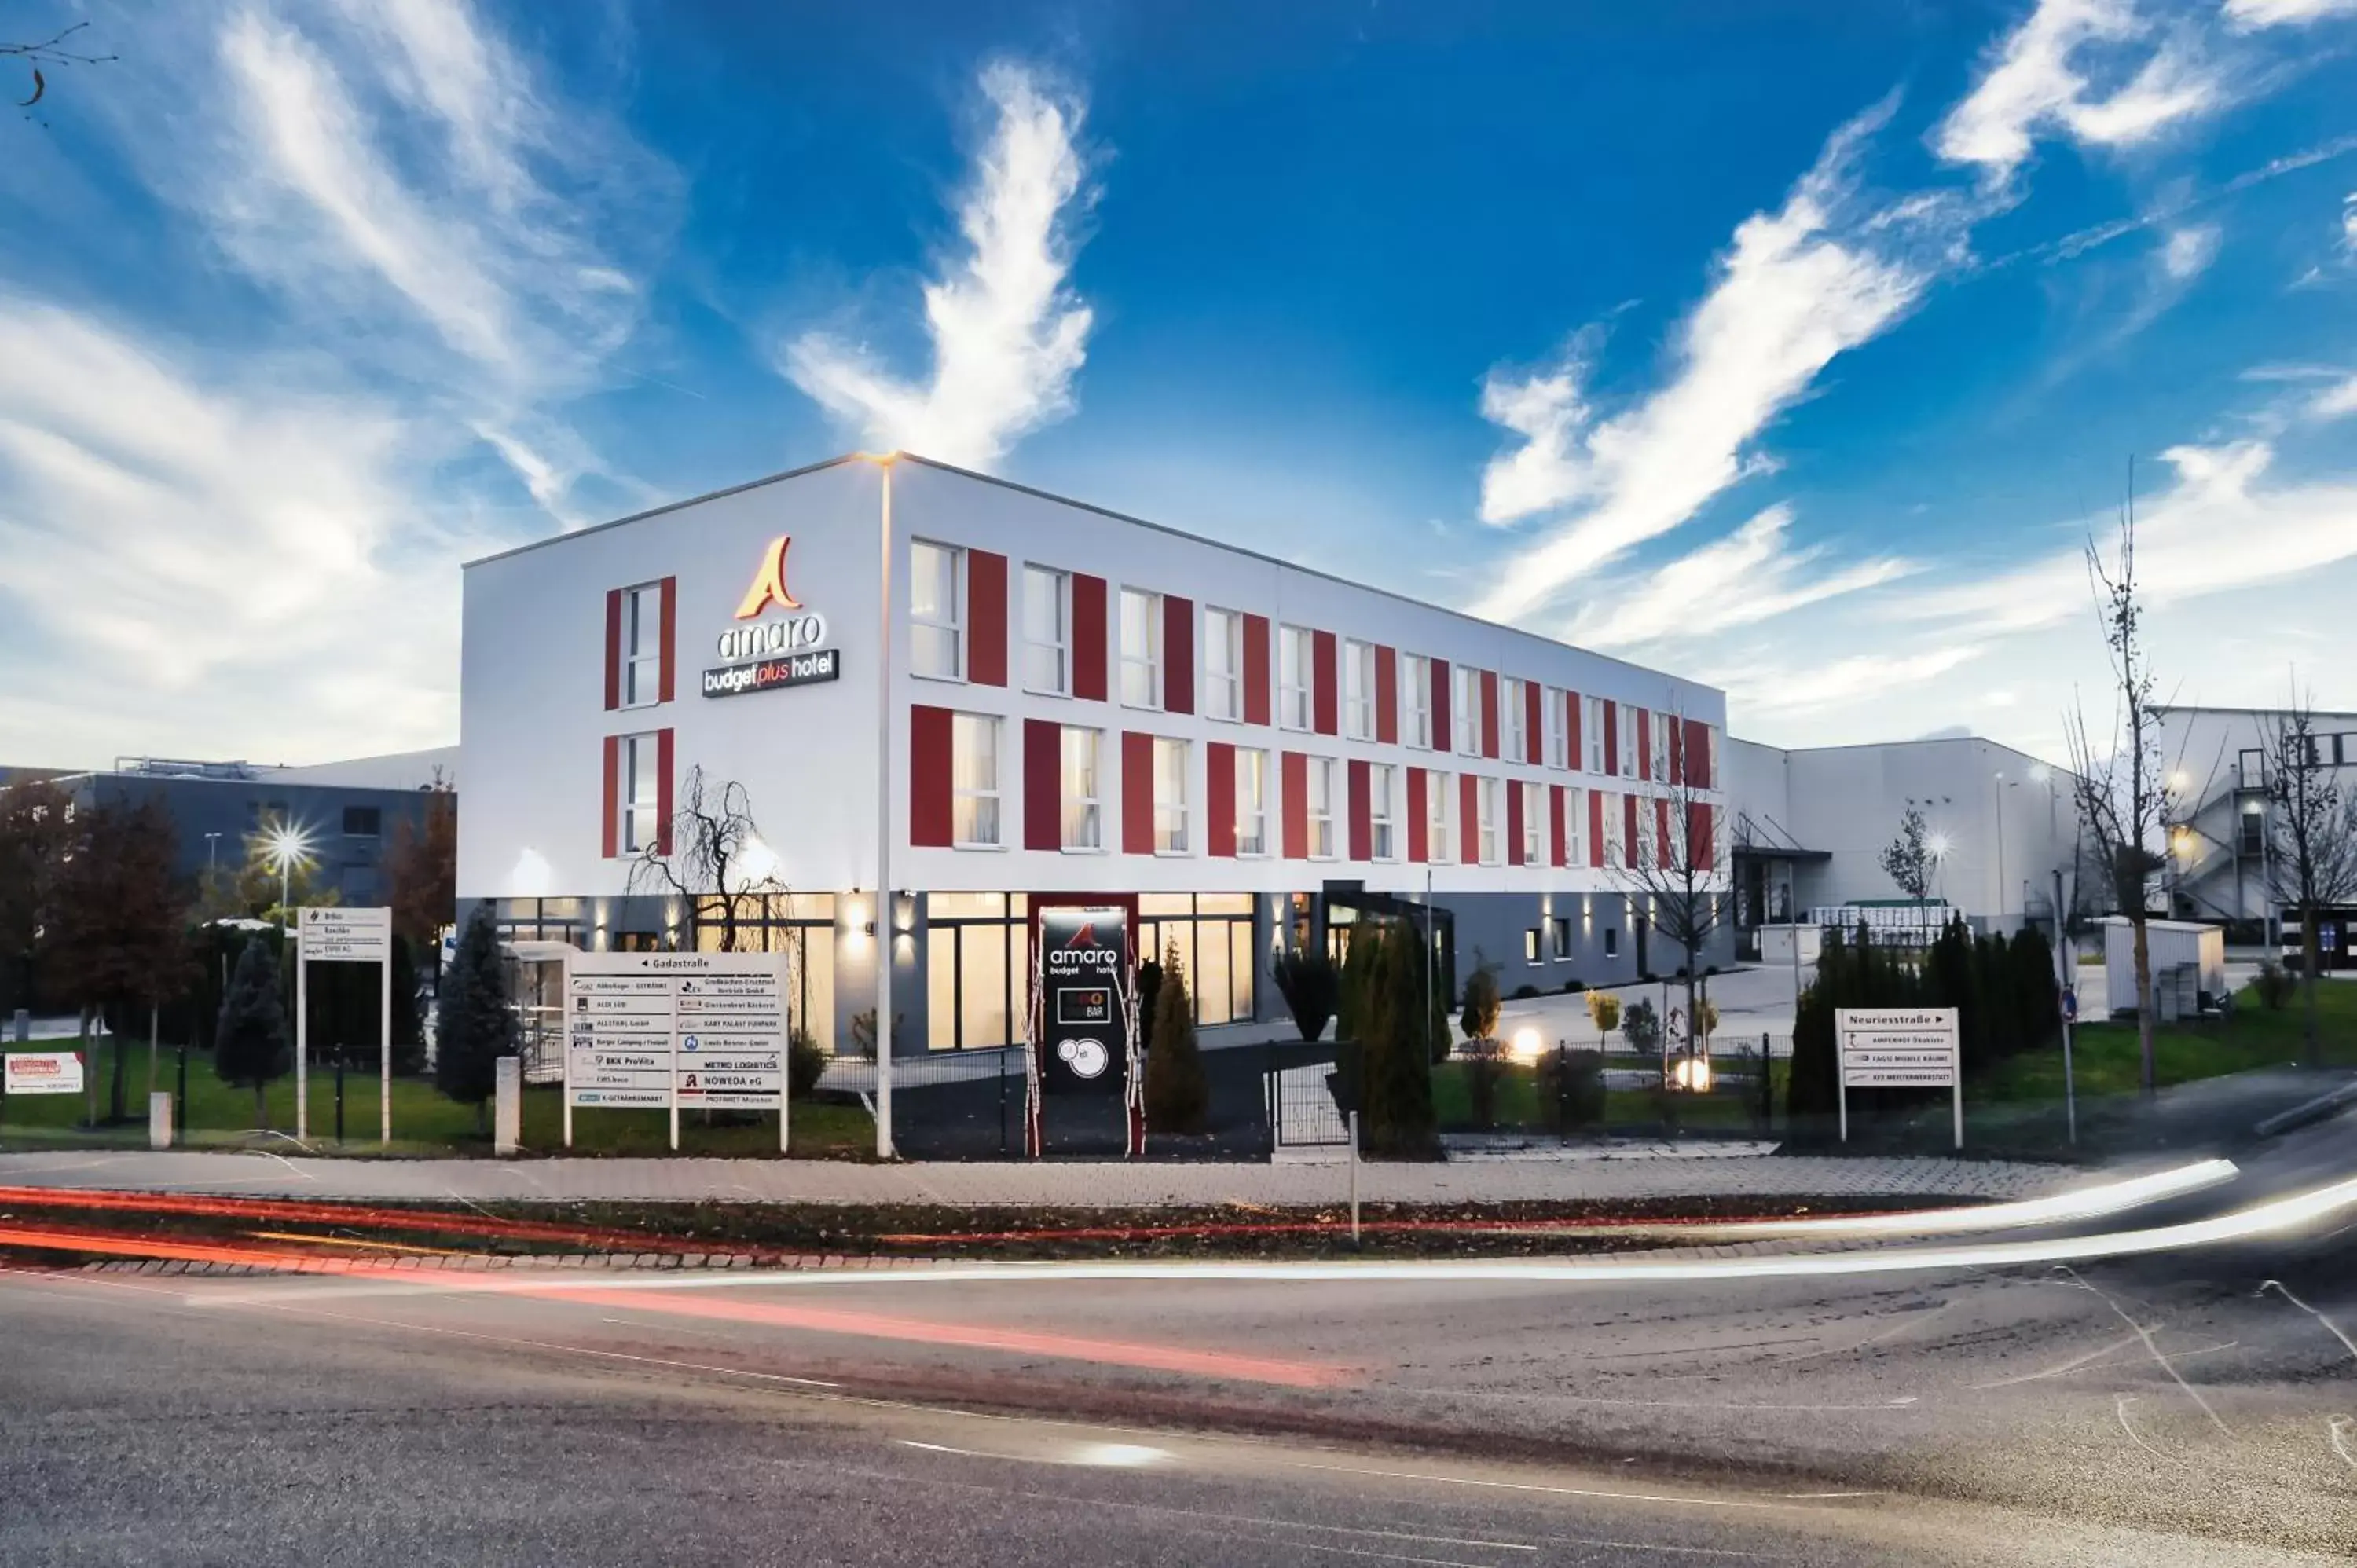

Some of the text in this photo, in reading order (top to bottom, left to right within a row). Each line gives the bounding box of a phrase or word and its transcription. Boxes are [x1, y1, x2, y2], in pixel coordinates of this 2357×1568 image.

[717, 615, 822, 660] amaro
[704, 651, 833, 691] budget plus hotel
[1050, 949, 1116, 964] amaro
[653, 958, 709, 968] Gadastraße
[1049, 966, 1080, 976] budget
[1849, 1015, 1930, 1024] Neuriesstraße
[625, 1057, 654, 1065] ProVita
[704, 1076, 761, 1085] NOWEDA eG
